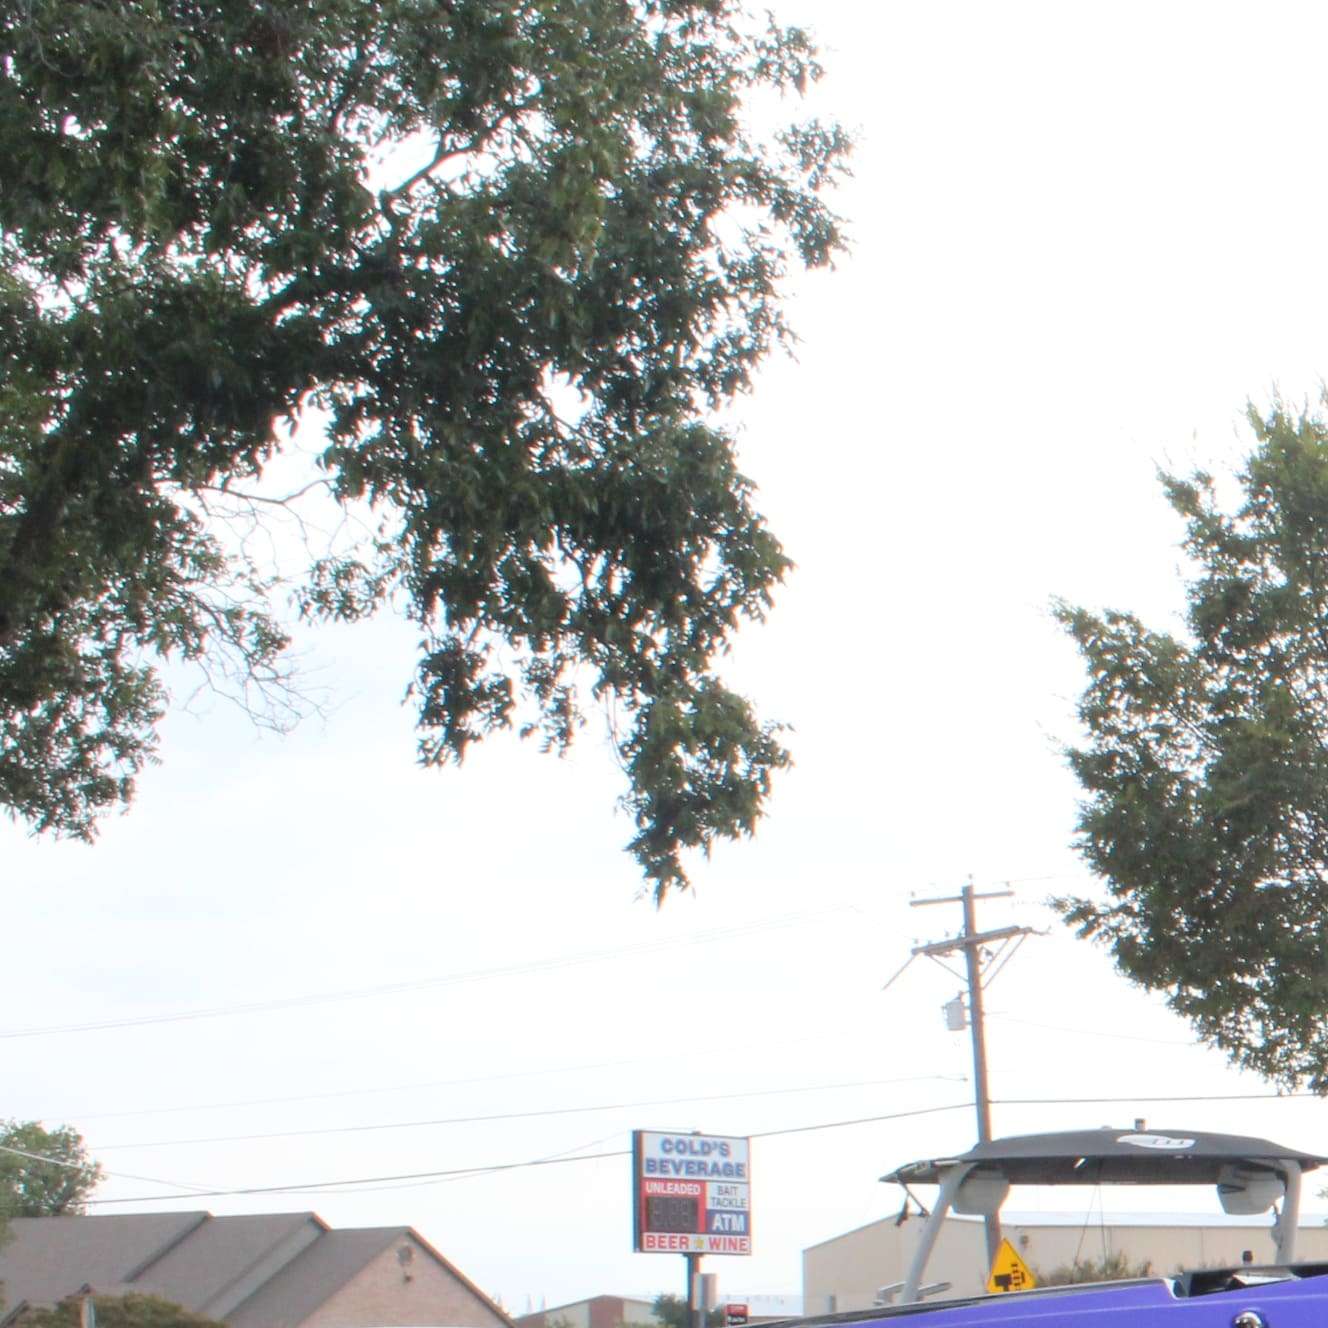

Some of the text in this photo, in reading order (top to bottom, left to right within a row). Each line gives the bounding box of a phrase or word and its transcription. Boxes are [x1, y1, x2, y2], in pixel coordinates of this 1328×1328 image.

[661, 1138, 730, 1157] COLD'S
[645, 1158, 746, 1178] BEVERAGE
[646, 1182, 701, 1196] UNLEADED
[717, 1185, 739, 1197] BAIT
[711, 1196, 747, 1209] TACKLE
[711, 1214, 745, 1232] ATM
[645, 1235, 749, 1251] BEER WINE
